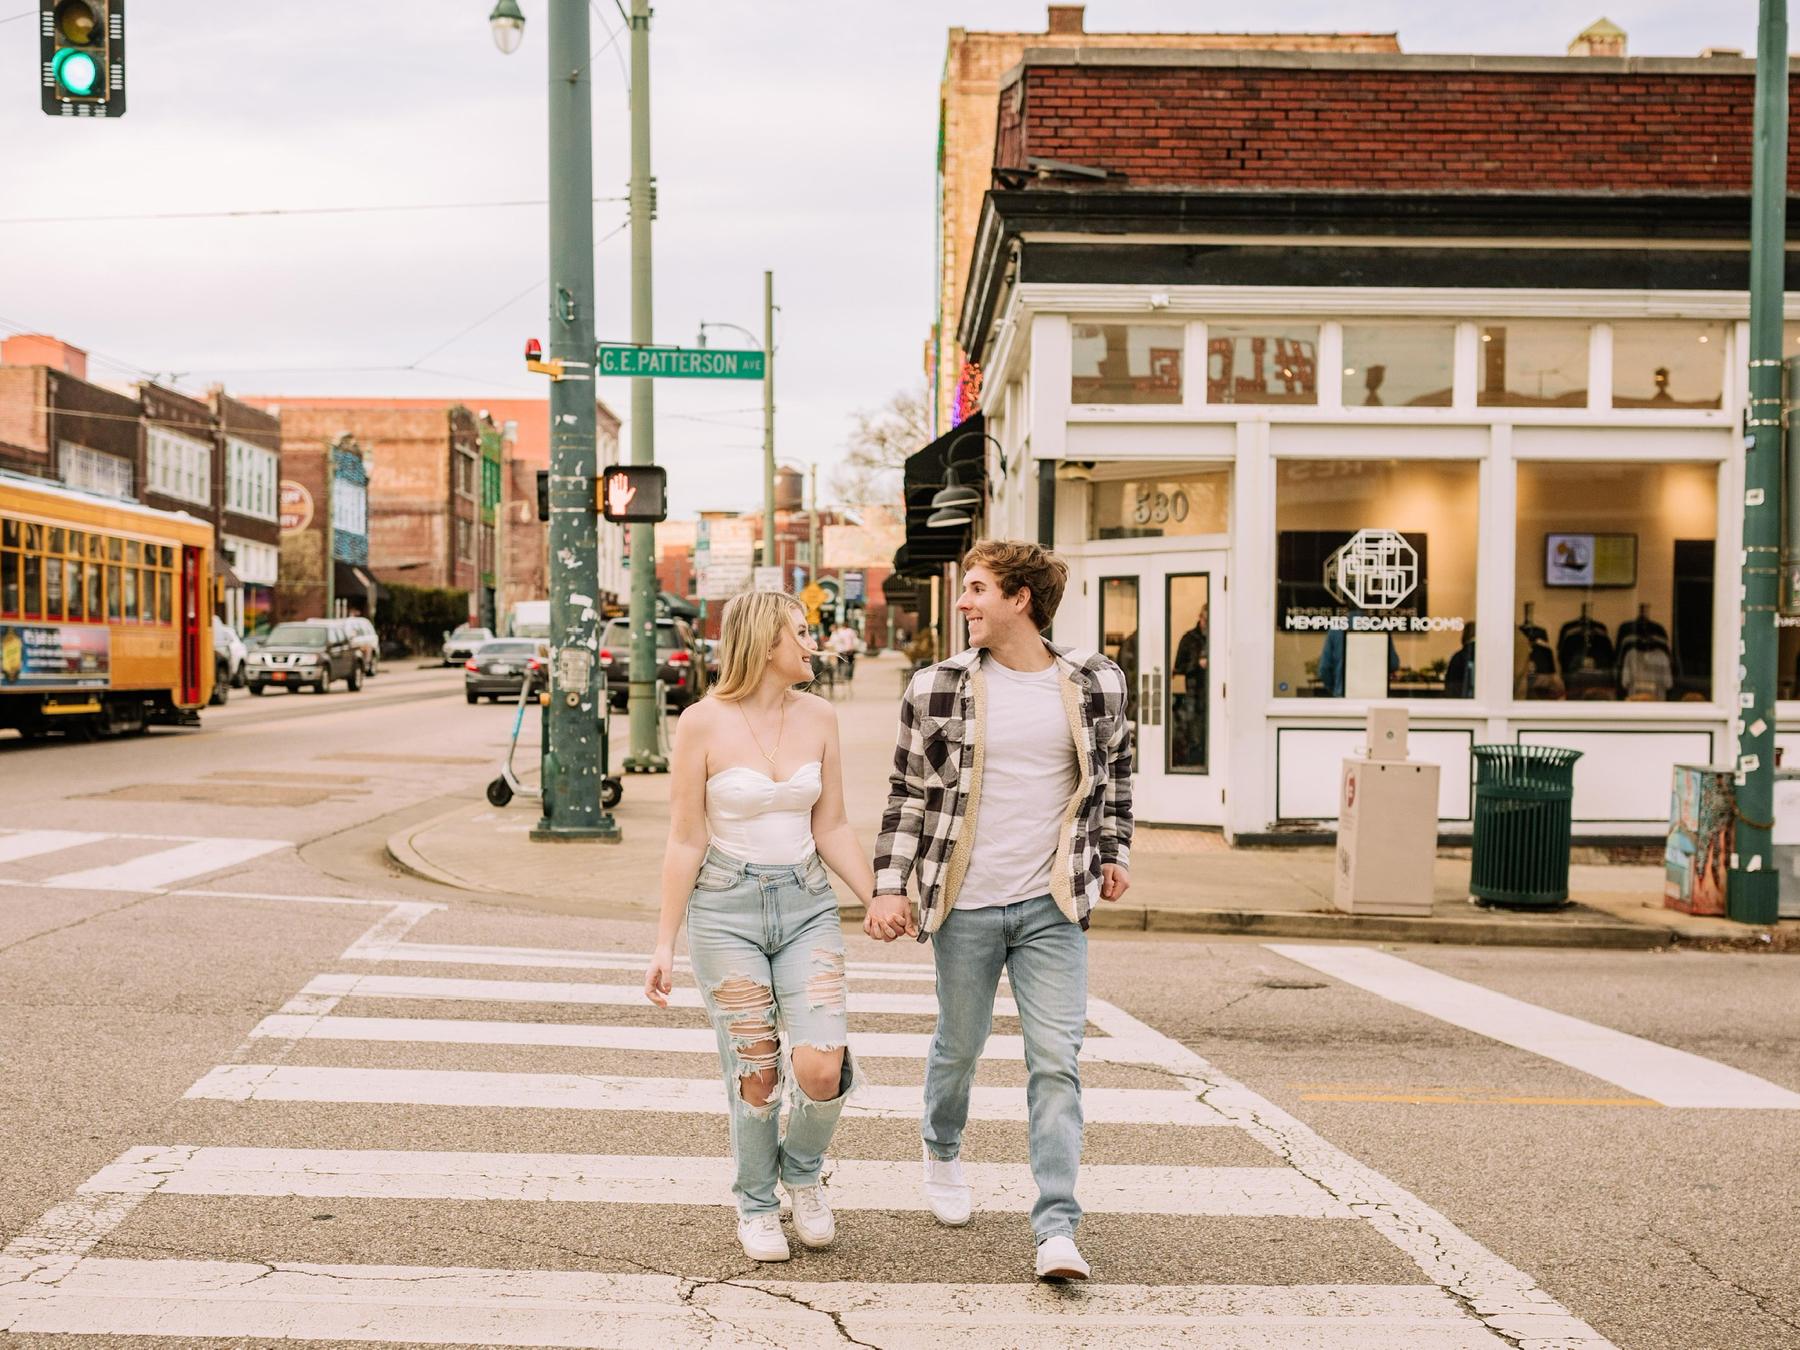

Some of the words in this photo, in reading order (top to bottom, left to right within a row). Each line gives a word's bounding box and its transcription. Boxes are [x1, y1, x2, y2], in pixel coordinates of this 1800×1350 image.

[743, 359, 762, 371] AVE
[1135, 490, 1190, 525] 530
[1285, 616, 1348, 631] MEMPHIS
[1352, 616, 1407, 631] ESCAPE
[1410, 616, 1465, 631] ROOMS
